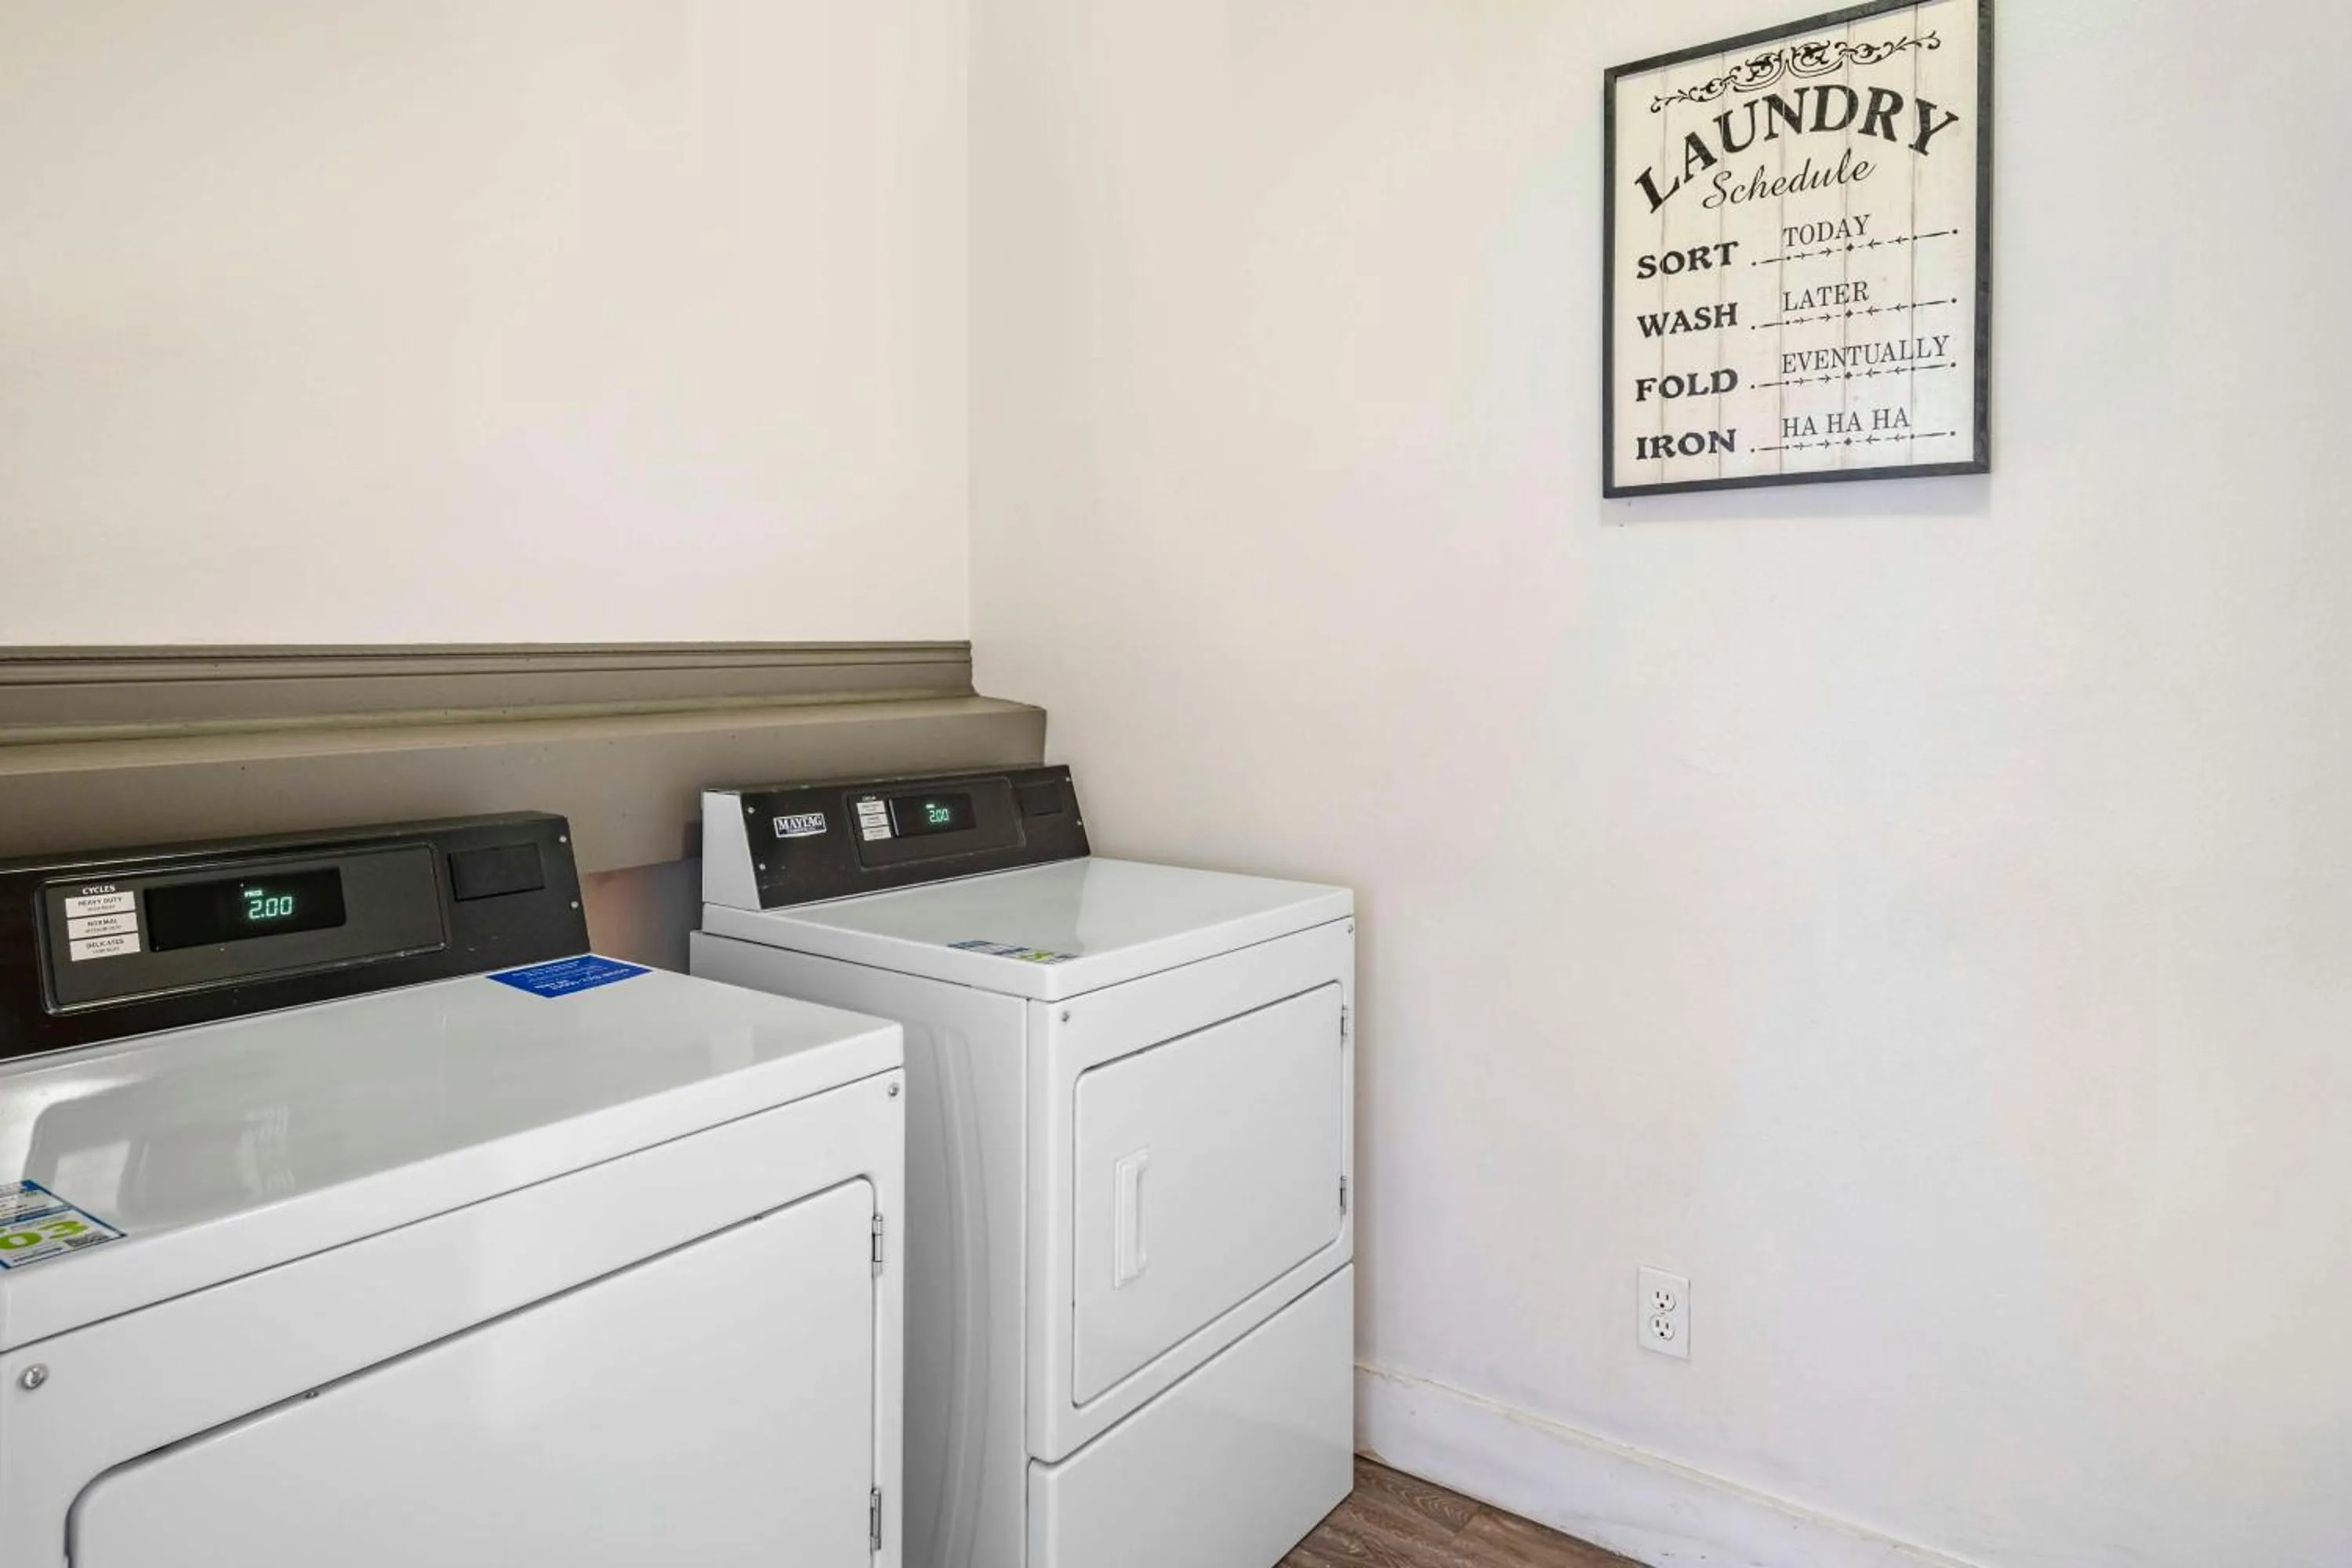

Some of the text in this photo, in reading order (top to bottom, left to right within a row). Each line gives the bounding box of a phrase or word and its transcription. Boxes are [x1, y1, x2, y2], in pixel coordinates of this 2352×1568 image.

[1635, 84, 1958, 213] LAUNDRY
[1702, 147, 1876, 209] Schedule
[1636, 214, 1871, 279] SORT TODAY
[1637, 281, 1870, 339] WASH LATER
[1635, 336, 1950, 401] FOLD EVENTUALLY
[1635, 407, 1911, 459] IRON HA HA HA
[778, 815, 822, 830] MAYTAG
[82, 884, 115, 895] CYCLES
[249, 896, 292, 920] 2.00
